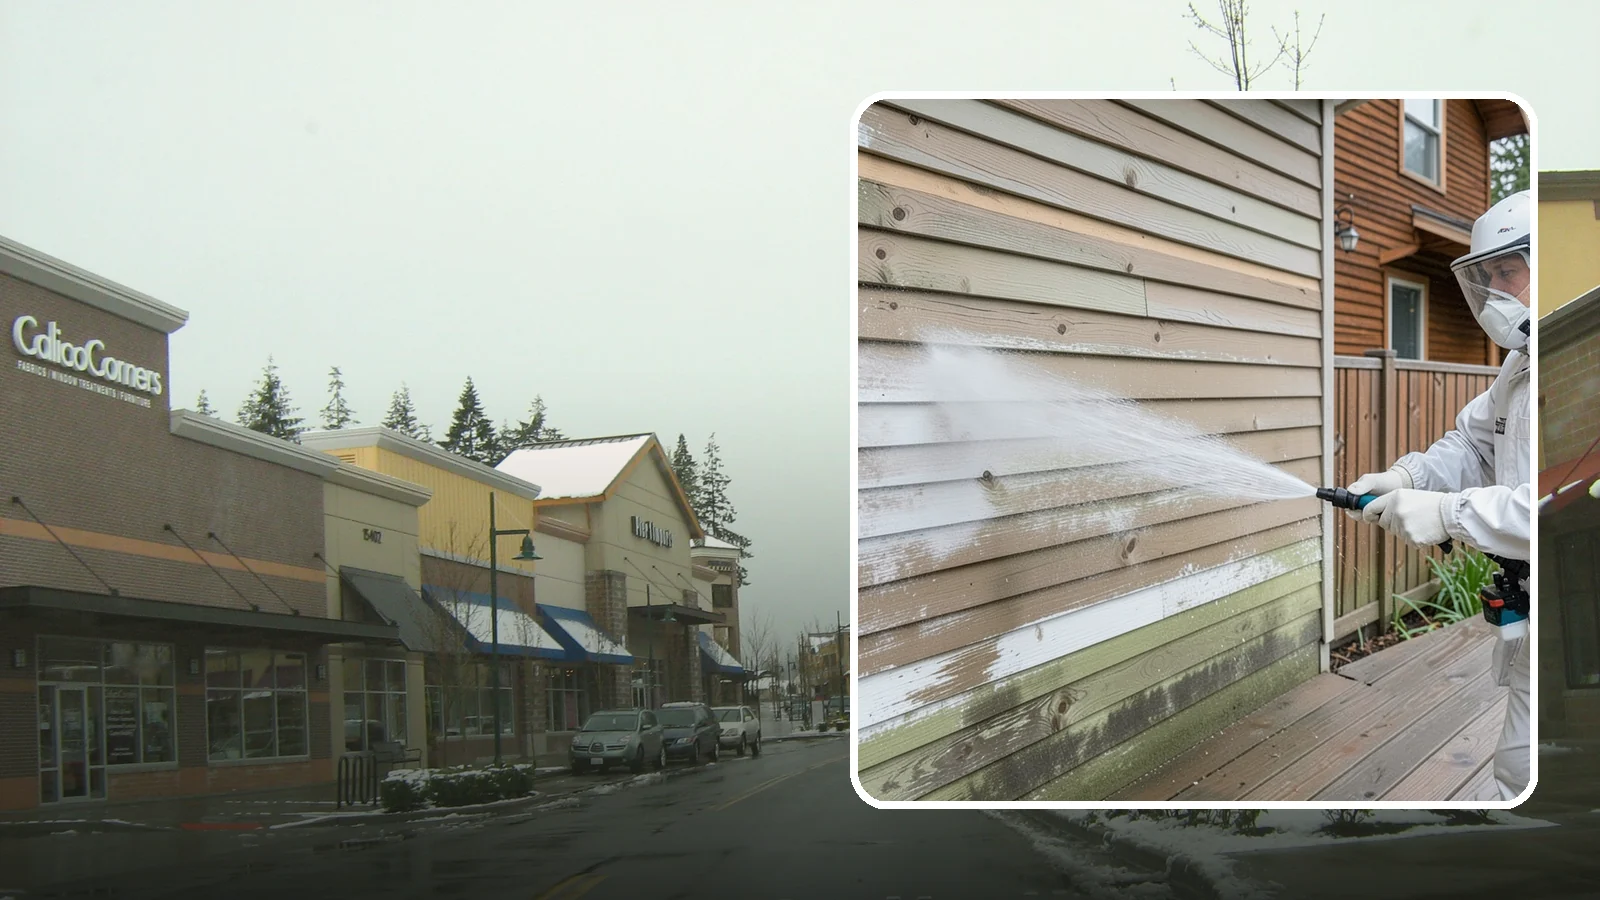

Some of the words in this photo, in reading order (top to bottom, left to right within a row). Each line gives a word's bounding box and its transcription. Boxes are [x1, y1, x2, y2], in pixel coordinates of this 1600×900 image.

[17, 360, 47, 377] FABRICS
[51, 369, 78, 386] WINDOW
[78, 378, 117, 398] TREATMENTS
[120, 392, 151, 408] FURNITURE
